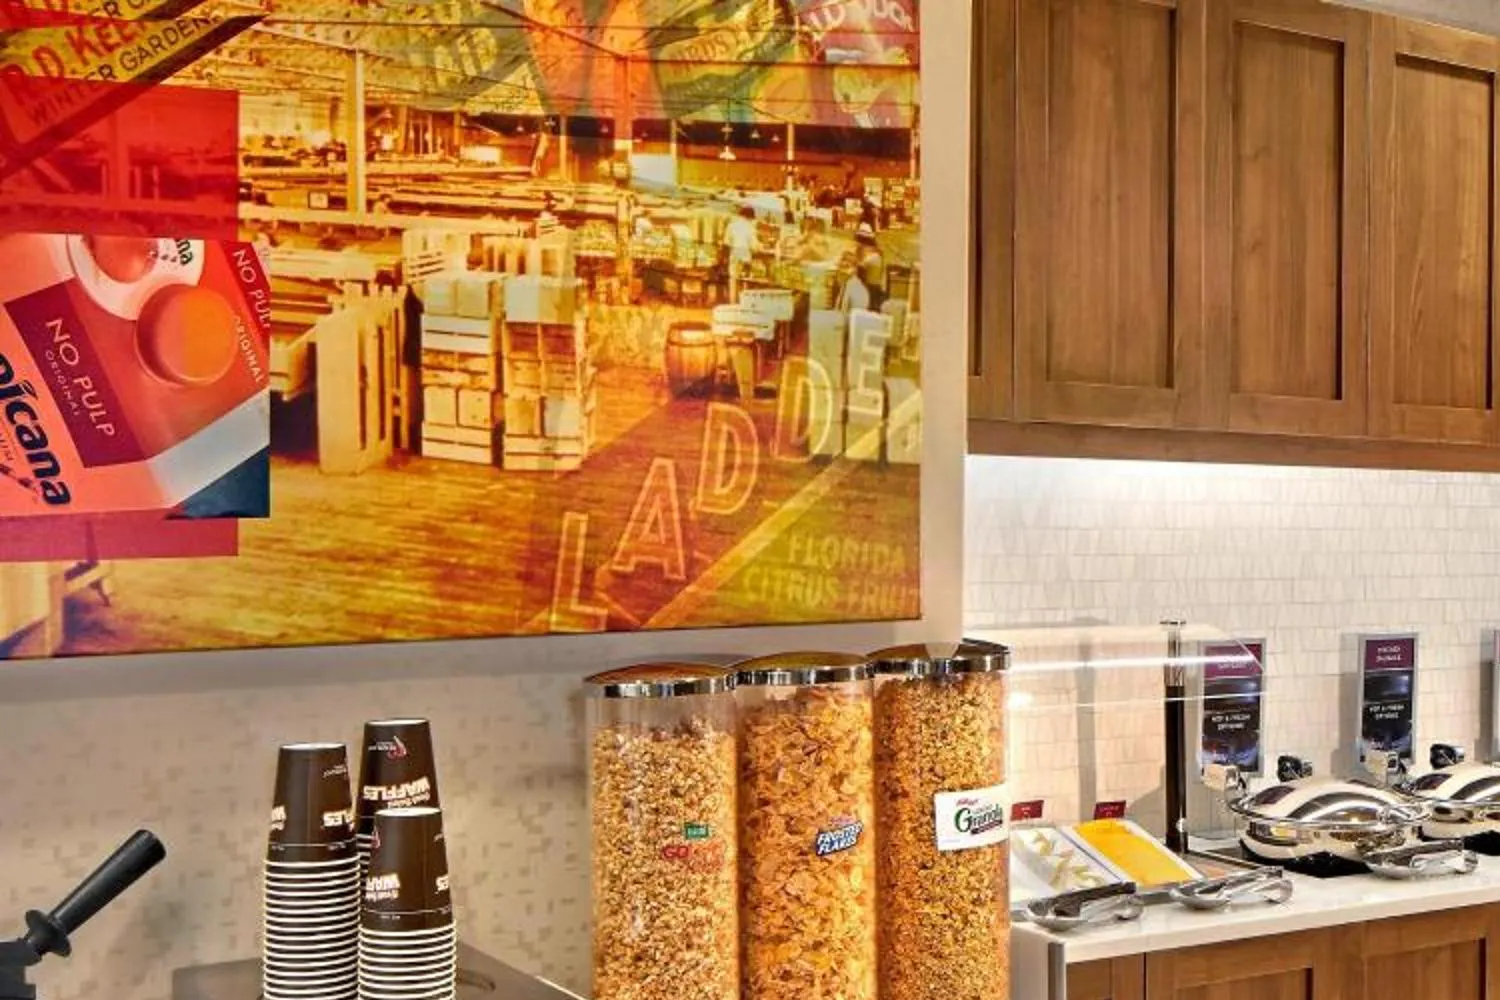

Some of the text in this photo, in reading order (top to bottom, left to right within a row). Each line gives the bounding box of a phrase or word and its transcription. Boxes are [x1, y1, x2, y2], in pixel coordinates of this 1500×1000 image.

[233, 249, 257, 285] NO
[45, 317, 116, 437] NO PULP
[787, 530, 905, 574] FLORIDA
[742, 563, 840, 607] CITRUS
